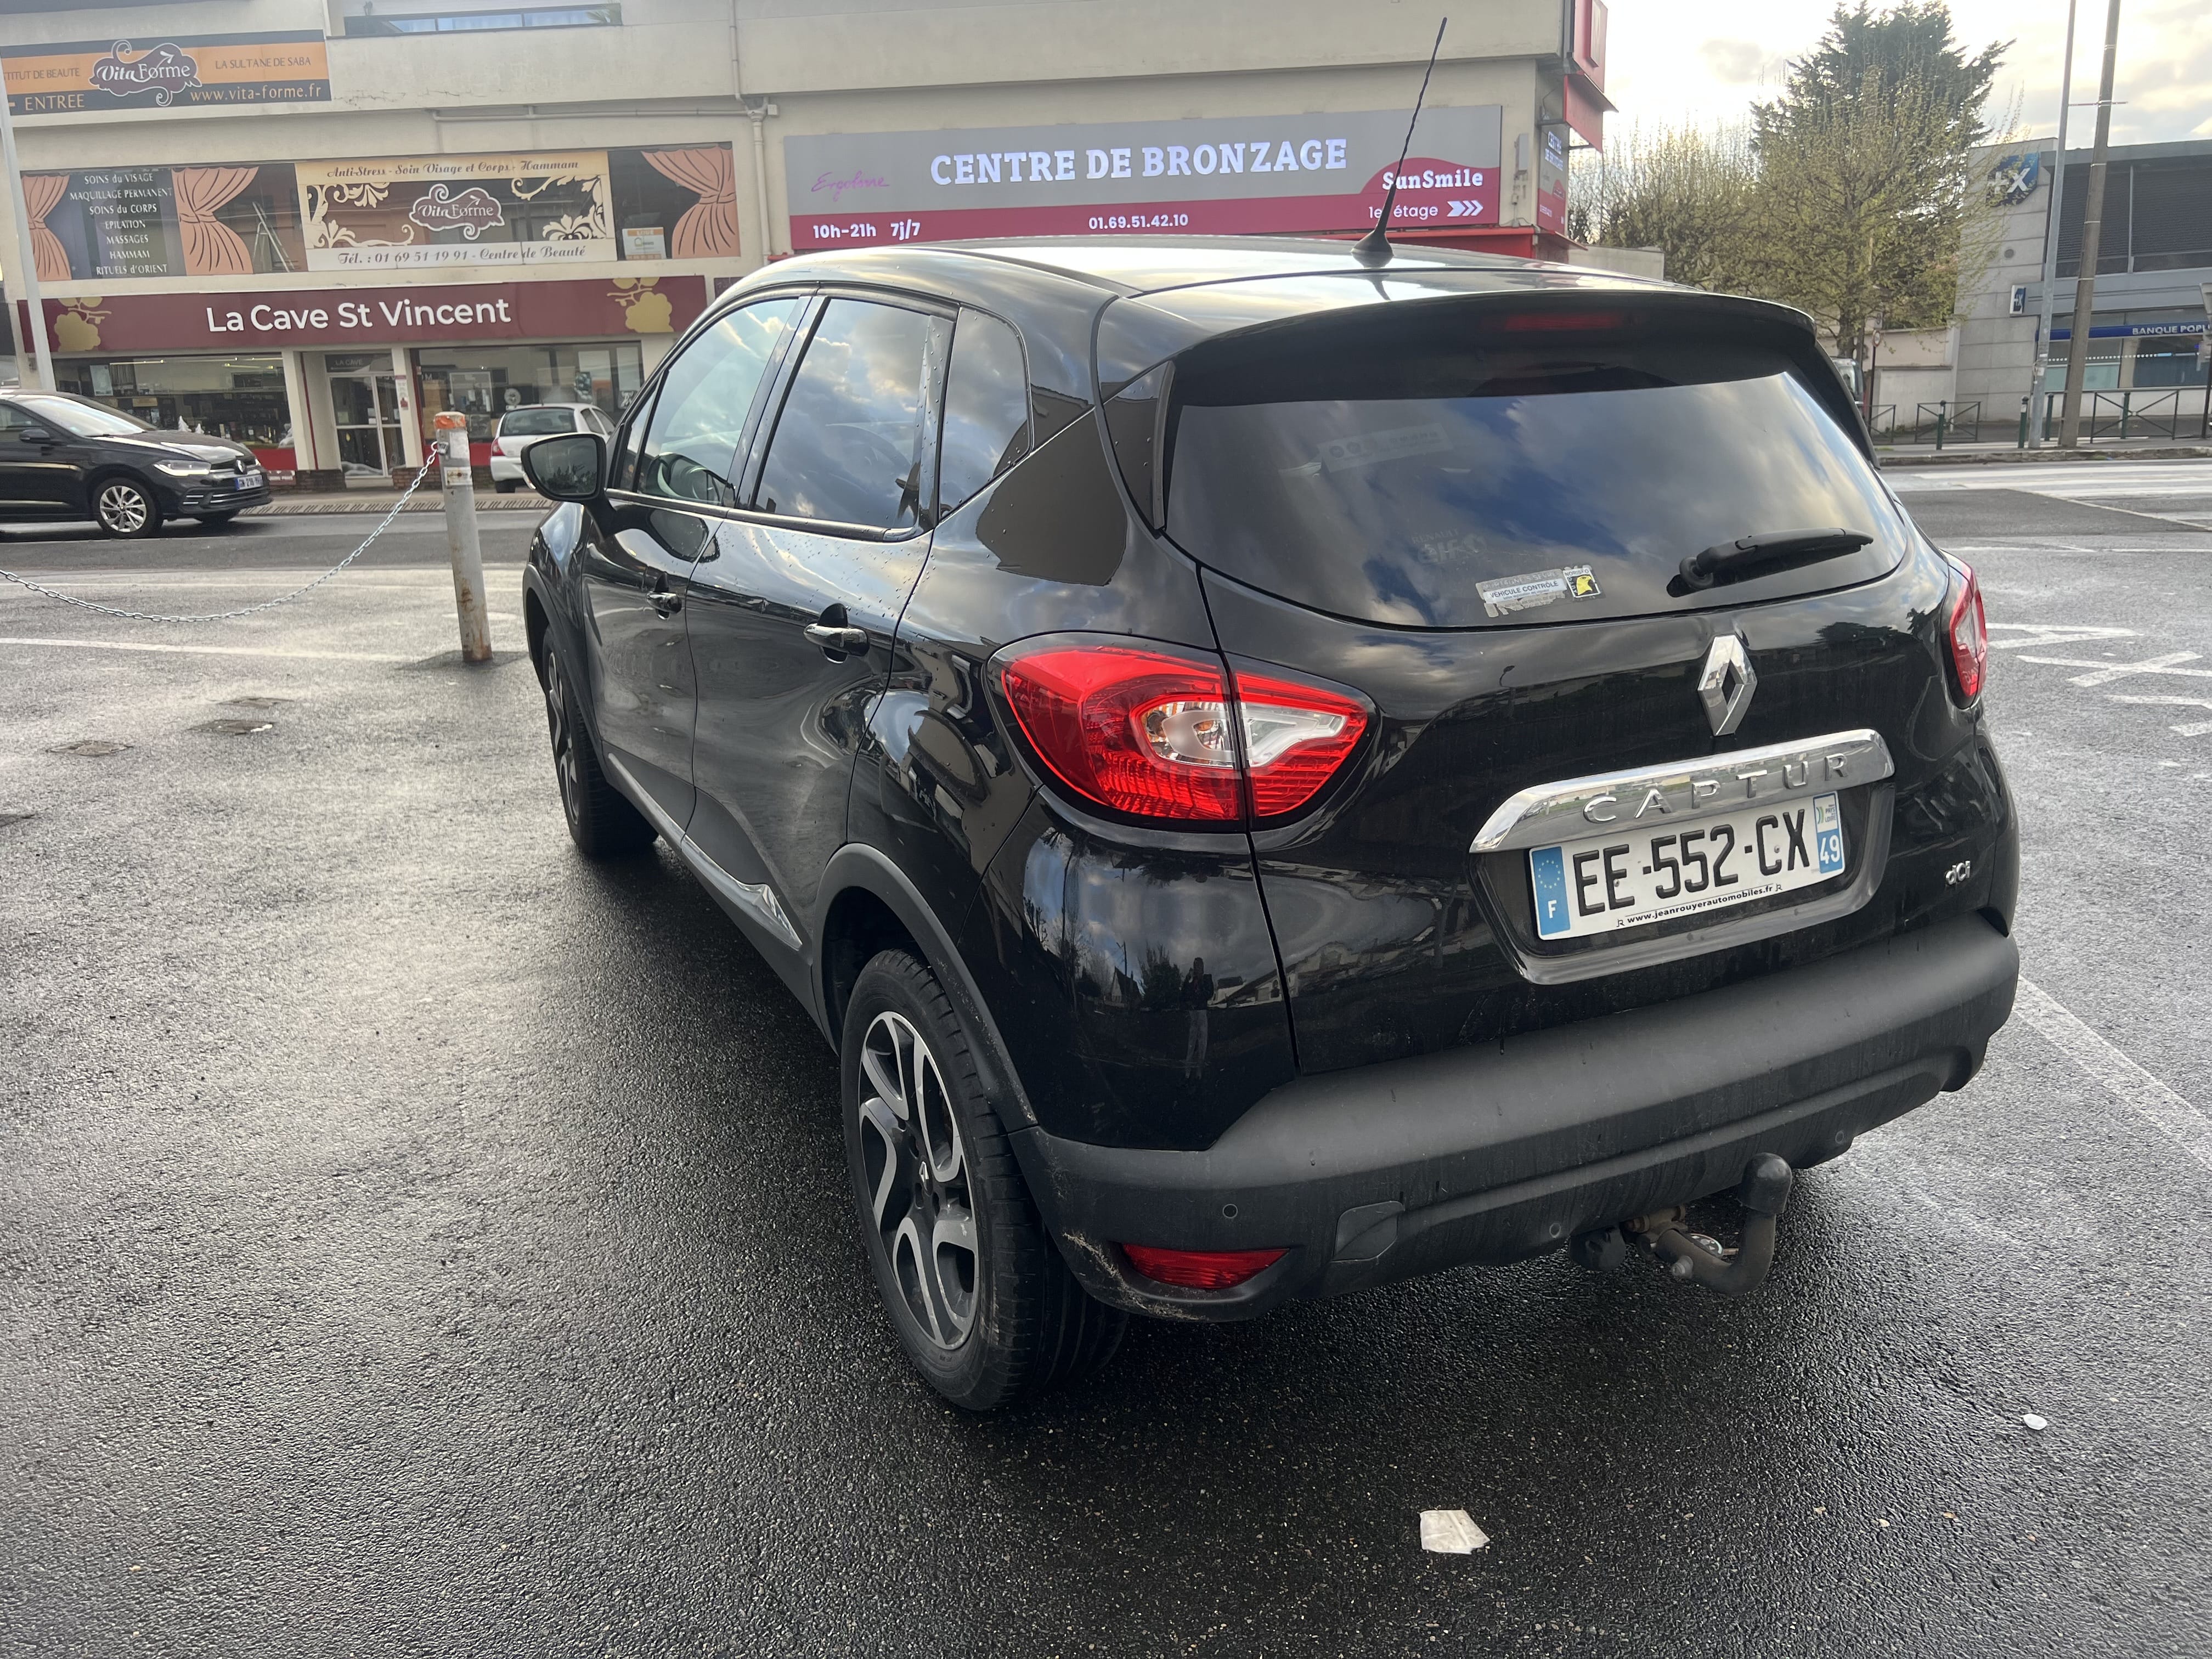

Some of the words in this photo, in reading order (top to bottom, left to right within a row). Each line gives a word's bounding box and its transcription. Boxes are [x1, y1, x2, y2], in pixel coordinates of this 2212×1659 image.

[216, 60, 228, 70] LA
[230, 58, 272, 69] SULTANE
[274, 57, 286, 66] DE
[288, 57, 311, 66] SABA
[4, 70, 31, 80] TITUT
[33, 70, 44, 78] DE
[47, 67, 81, 78] BEAUTE
[190, 83, 321, 101] www.vita-forme.fr
[25, 94, 85, 110] ENTREE
[327, 166, 386, 178] Anti-Stress
[395, 164, 420, 174] Soin
[423, 163, 462, 175] Visage
[478, 162, 509, 173] Corps
[520, 160, 579, 171] Hammam
[930, 150, 1076, 185] CENTRE
[1086, 148, 1131, 179] DE
[1142, 138, 1347, 177] BRONZAGE
[84, 174, 109, 184] SOINS
[112, 173, 122, 183] du
[125, 173, 154, 183] VISAGE
[1382, 168, 1483, 190] SunSmile
[70, 189, 122, 202] MAQUILLAGE
[125, 187, 173, 198] PERMANENT
[89, 205, 114, 215] SOINS
[117, 205, 127, 213] du
[131, 203, 157, 213] CORPS
[1393, 204, 1438, 220] étage
[105, 219, 146, 230] EPILATION
[812, 223, 877, 239] 10h-21h
[890, 218, 921, 241] 7j/7
[1088, 213, 1189, 230] 01.69.51.42.10
[106, 234, 149, 245] MASSAGES
[109, 250, 150, 259] HAMMAM
[337, 252, 363, 264] Tél.
[375, 252, 388, 263] 01
[394, 251, 410, 262] 69
[414, 251, 428, 262] 51
[436, 250, 449, 261] 19
[453, 250, 467, 260] 91
[480, 249, 518, 259] Centre
[523, 247, 536, 258] de
[540, 245, 586, 258] Beauté
[96, 266, 127, 275] RITUELS
[131, 264, 167, 274] d'ORIENT
[206, 307, 244, 332] La
[250, 303, 329, 331] Cave
[338, 302, 373, 328] St
[379, 298, 511, 327] Vincent
[2132, 326, 2177, 335] BANQUE
[1583, 752, 1849, 824] CAPTUR
[1820, 834, 1840, 865] 49
[1573, 809, 1810, 917] EE-552-CX
[1547, 899, 1557, 919] F
[1627, 884, 1773, 924] www.jeanrouyerautomobiles.fr
